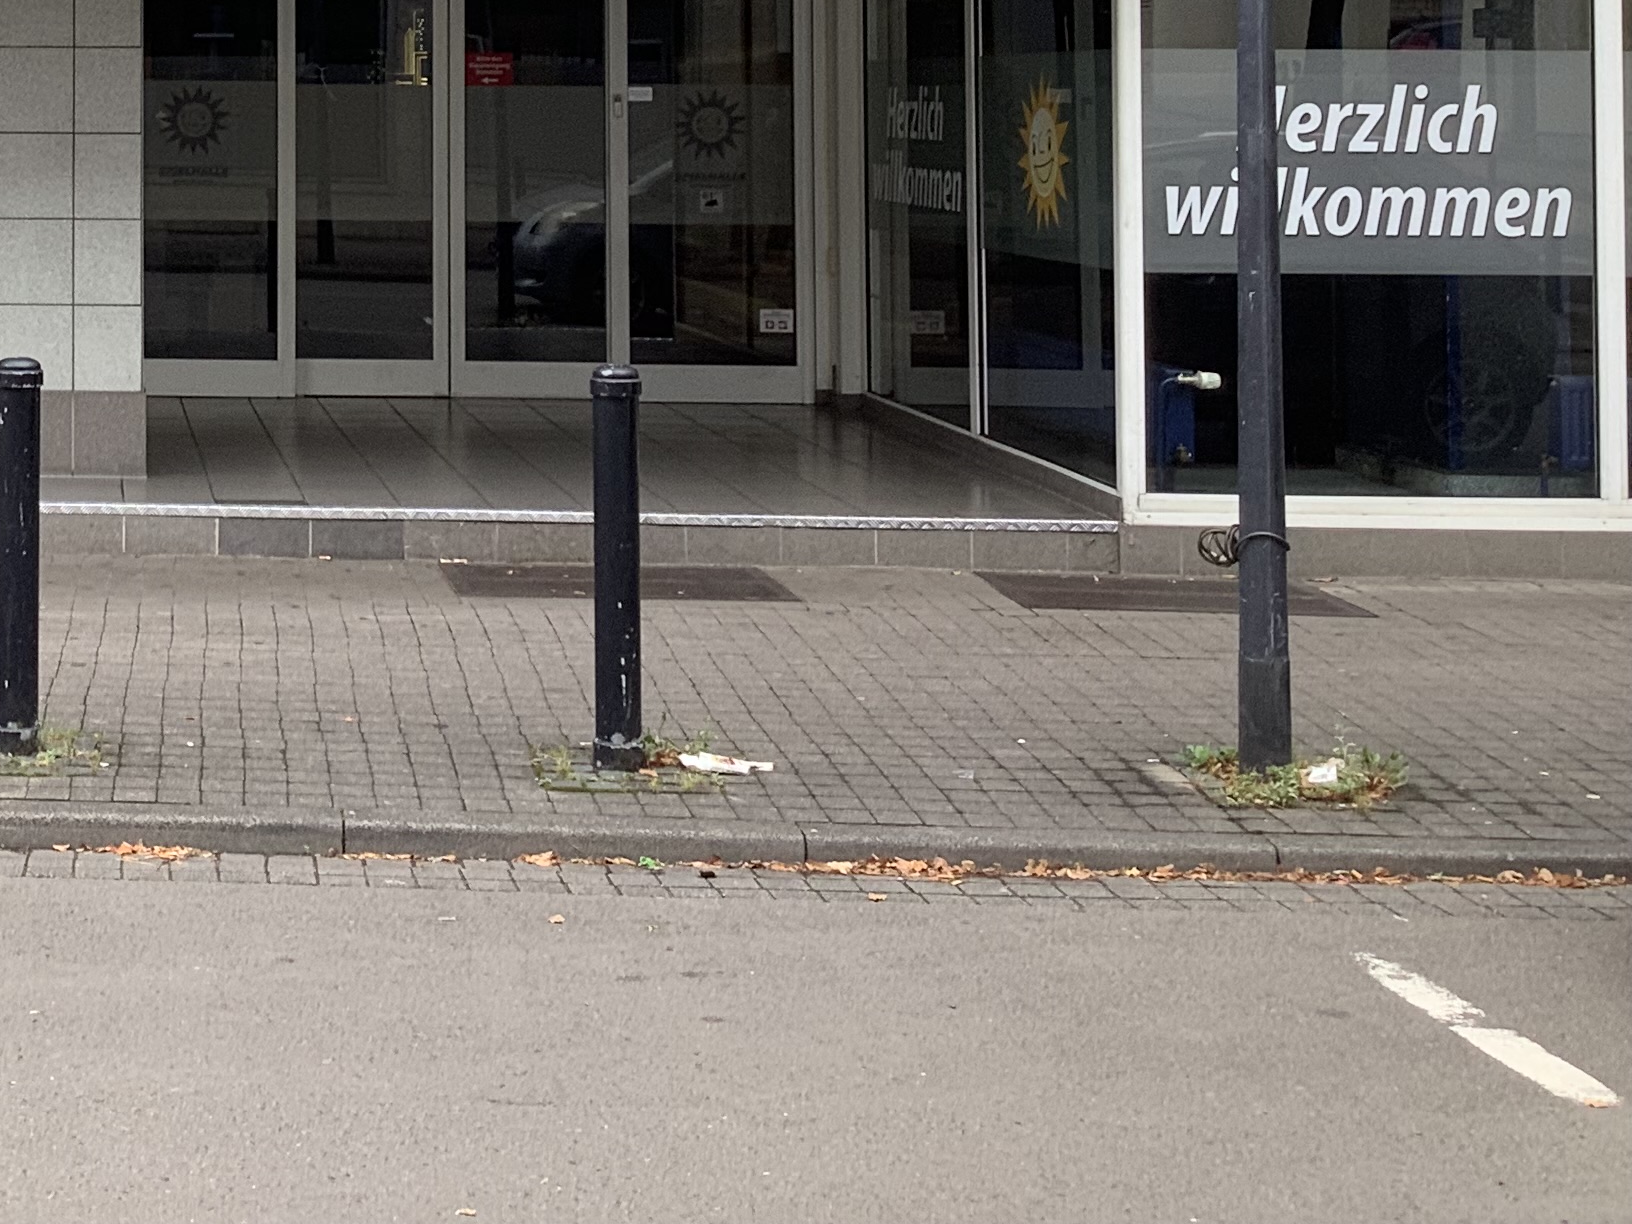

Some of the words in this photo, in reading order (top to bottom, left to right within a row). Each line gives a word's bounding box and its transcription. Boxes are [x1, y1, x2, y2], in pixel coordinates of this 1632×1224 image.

[886, 85, 945, 141] Herzlich
[872, 150, 963, 213] willkommen
[1165, 165, 1574, 237] wikommen
